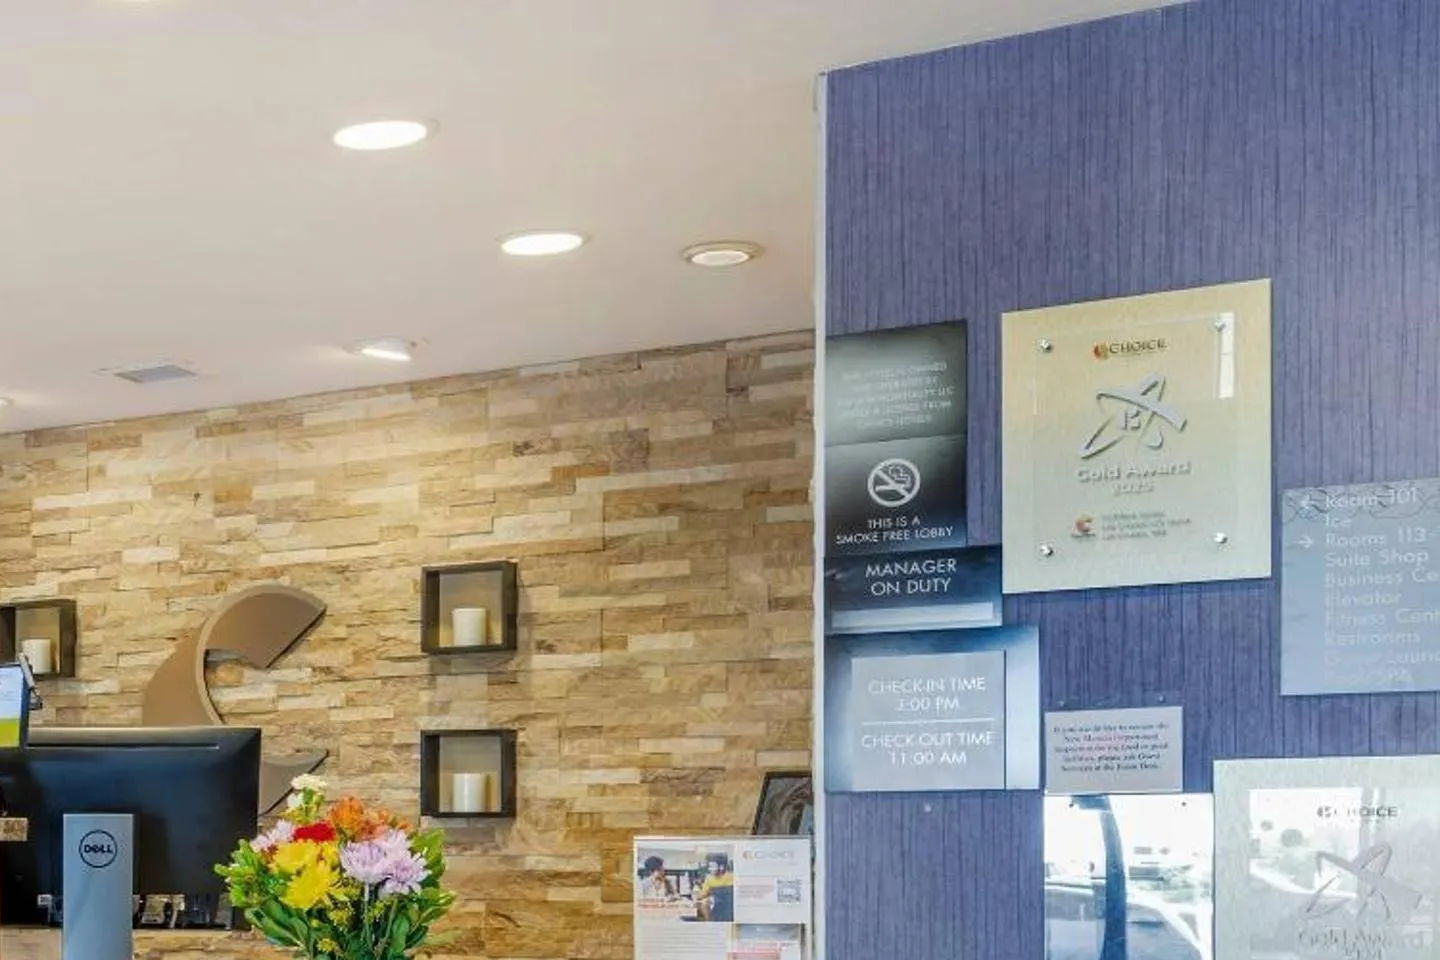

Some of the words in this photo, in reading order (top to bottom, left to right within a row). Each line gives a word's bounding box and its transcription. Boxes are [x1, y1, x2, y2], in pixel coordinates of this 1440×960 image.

[1108, 338, 1168, 355] CHOICE
[1077, 463, 1121, 483] Gold
[1125, 459, 1192, 479] Award
[1326, 494, 1379, 510] Room
[867, 518, 892, 530] THIS
[896, 516, 907, 527] IS
[911, 515, 921, 526] A
[836, 532, 879, 546] SMOKE
[883, 529, 910, 542] FREE
[914, 526, 954, 539] LOBBY
[1325, 532, 1388, 547] Rooms
[1325, 551, 1371, 567] Suite
[1379, 547, 1429, 569] Shop
[865, 558, 958, 578] MANAGER
[870, 581, 901, 596] ON
[907, 577, 952, 594] DUTY
[1325, 571, 1404, 589] Business
[1325, 589, 1402, 608] Elevator
[951, 676, 987, 692] TIME
[935, 695, 960, 712] PM
[861, 734, 915, 749] CHECK
[918, 732, 953, 747] OUT
[956, 730, 997, 746] TIME
[887, 751, 934, 766] 11:00
[939, 750, 967, 765] AM
[84, 844, 114, 854] DELL
